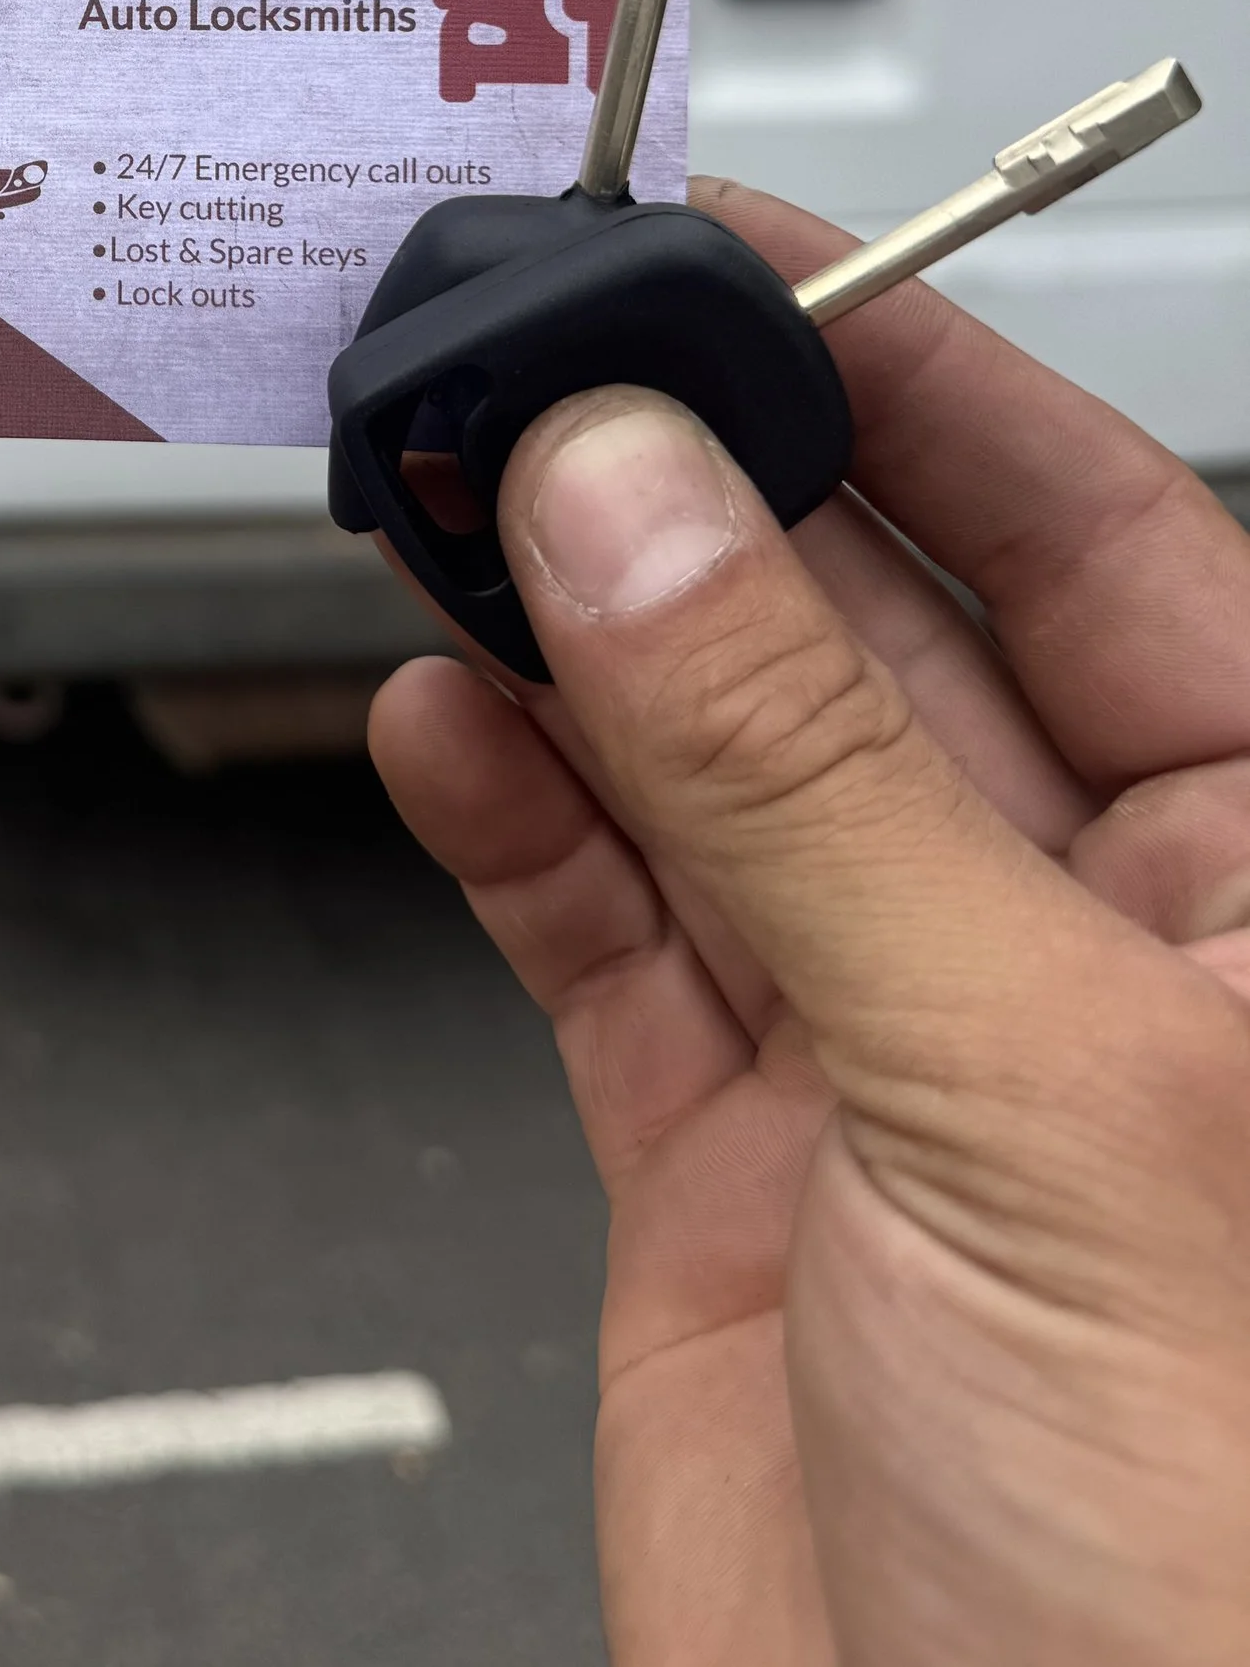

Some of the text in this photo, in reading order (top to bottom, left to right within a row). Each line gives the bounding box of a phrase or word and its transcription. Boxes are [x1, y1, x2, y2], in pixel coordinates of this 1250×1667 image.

[116, 152, 492, 189] 24/7 Emergency call outs
[118, 193, 285, 228] Key cutting
[111, 236, 367, 273] Lost & Spare keys
[117, 279, 256, 309] Lock outs
